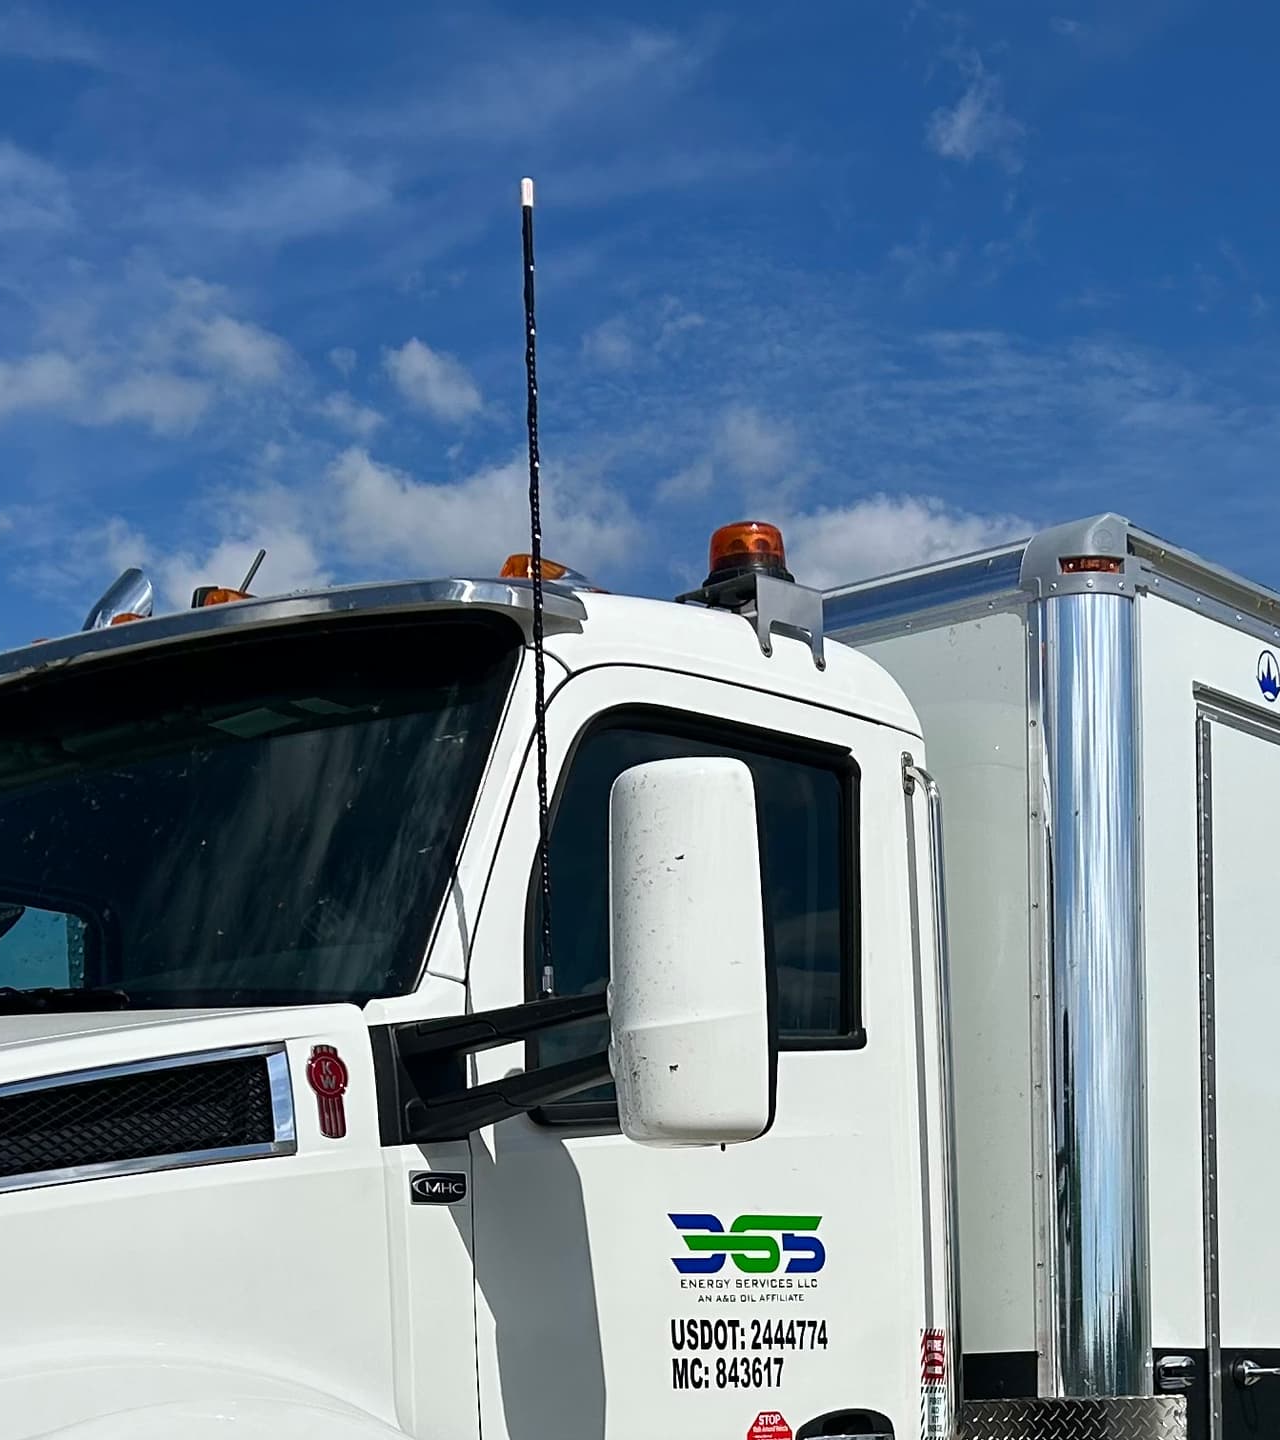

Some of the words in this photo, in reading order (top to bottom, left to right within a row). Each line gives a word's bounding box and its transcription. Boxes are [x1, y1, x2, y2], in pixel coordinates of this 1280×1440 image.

[667, 1213, 826, 1274] 365
[680, 1278, 731, 1289] ENERGY
[735, 1278, 793, 1288] SERVICES
[797, 1278, 818, 1288] LLC
[698, 1294, 712, 1302] AN
[740, 1294, 756, 1302] OIL
[760, 1293, 805, 1302] AFFILIATE
[670, 1319, 746, 1351] USDOT:
[751, 1319, 829, 1350] 2444774
[672, 1357, 710, 1389] MC:
[716, 1356, 784, 1389] 843617
[758, 1414, 780, 1426] STOP
